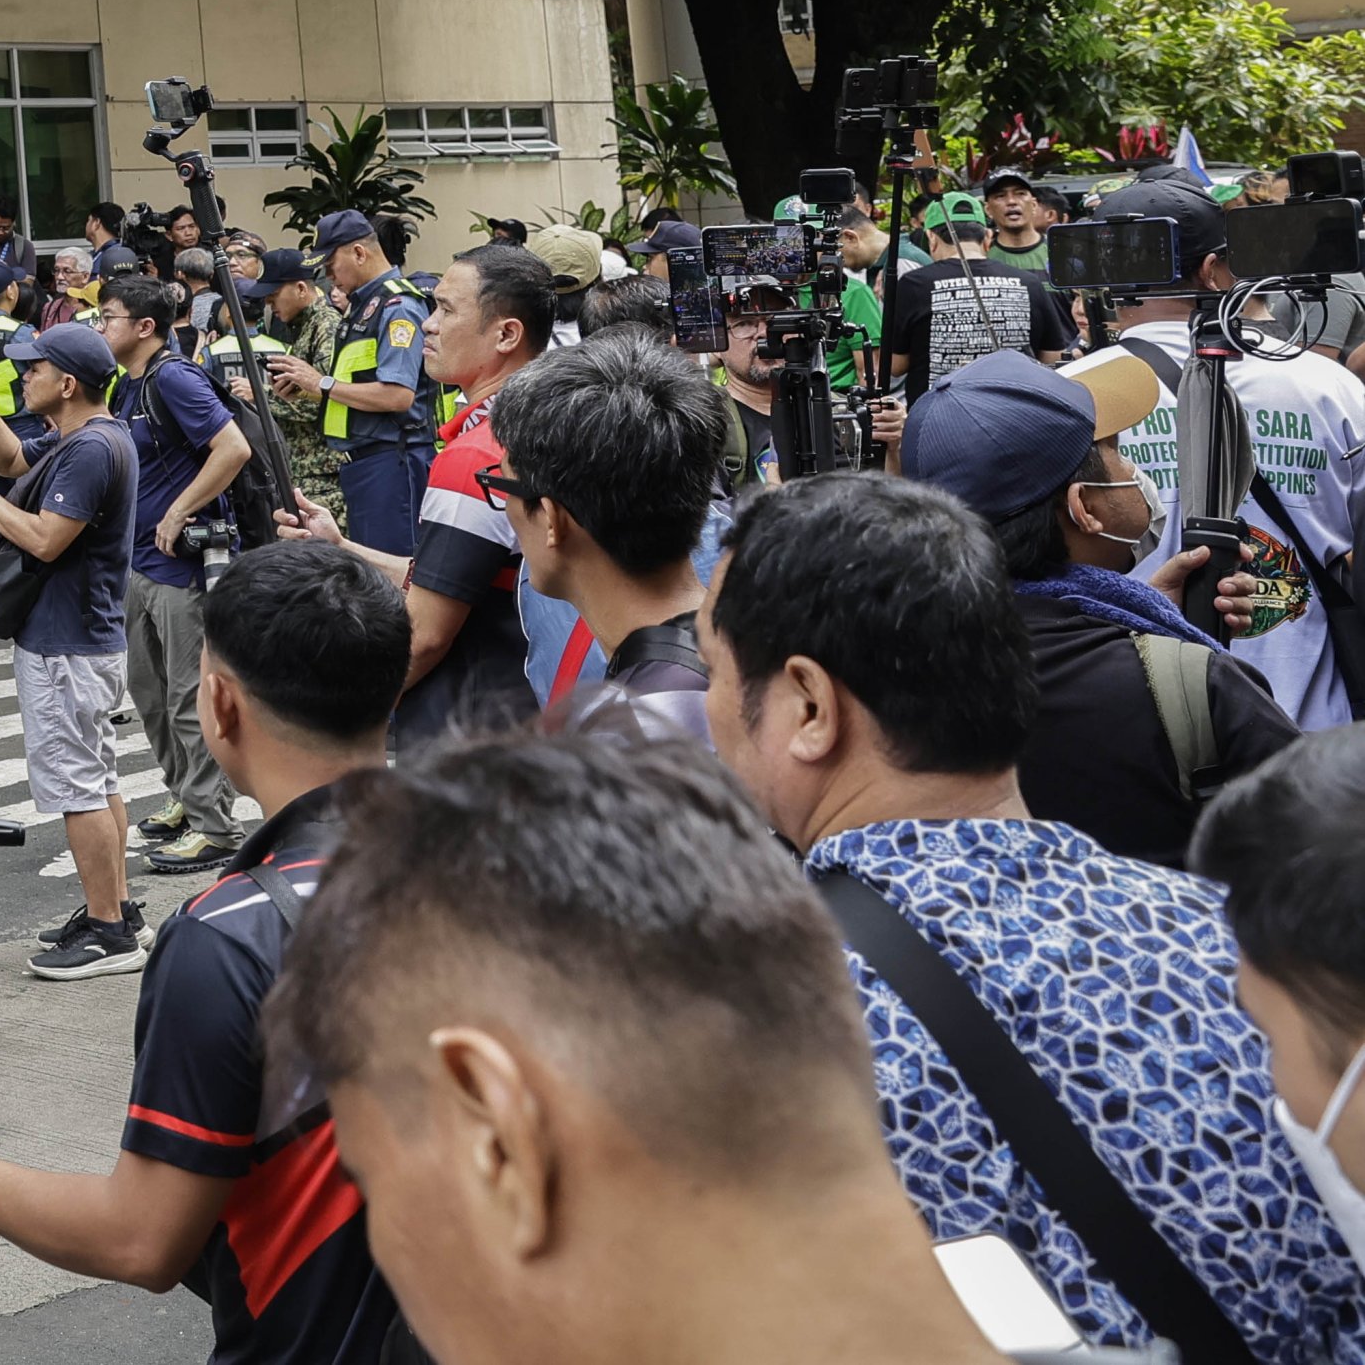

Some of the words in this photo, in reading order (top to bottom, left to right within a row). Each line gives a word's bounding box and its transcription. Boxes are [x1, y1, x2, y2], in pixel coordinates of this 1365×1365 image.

[934, 277, 982, 290] DUTERE
[983, 276, 1021, 287] LEGACY
[1256, 409, 1314, 441] SARA
